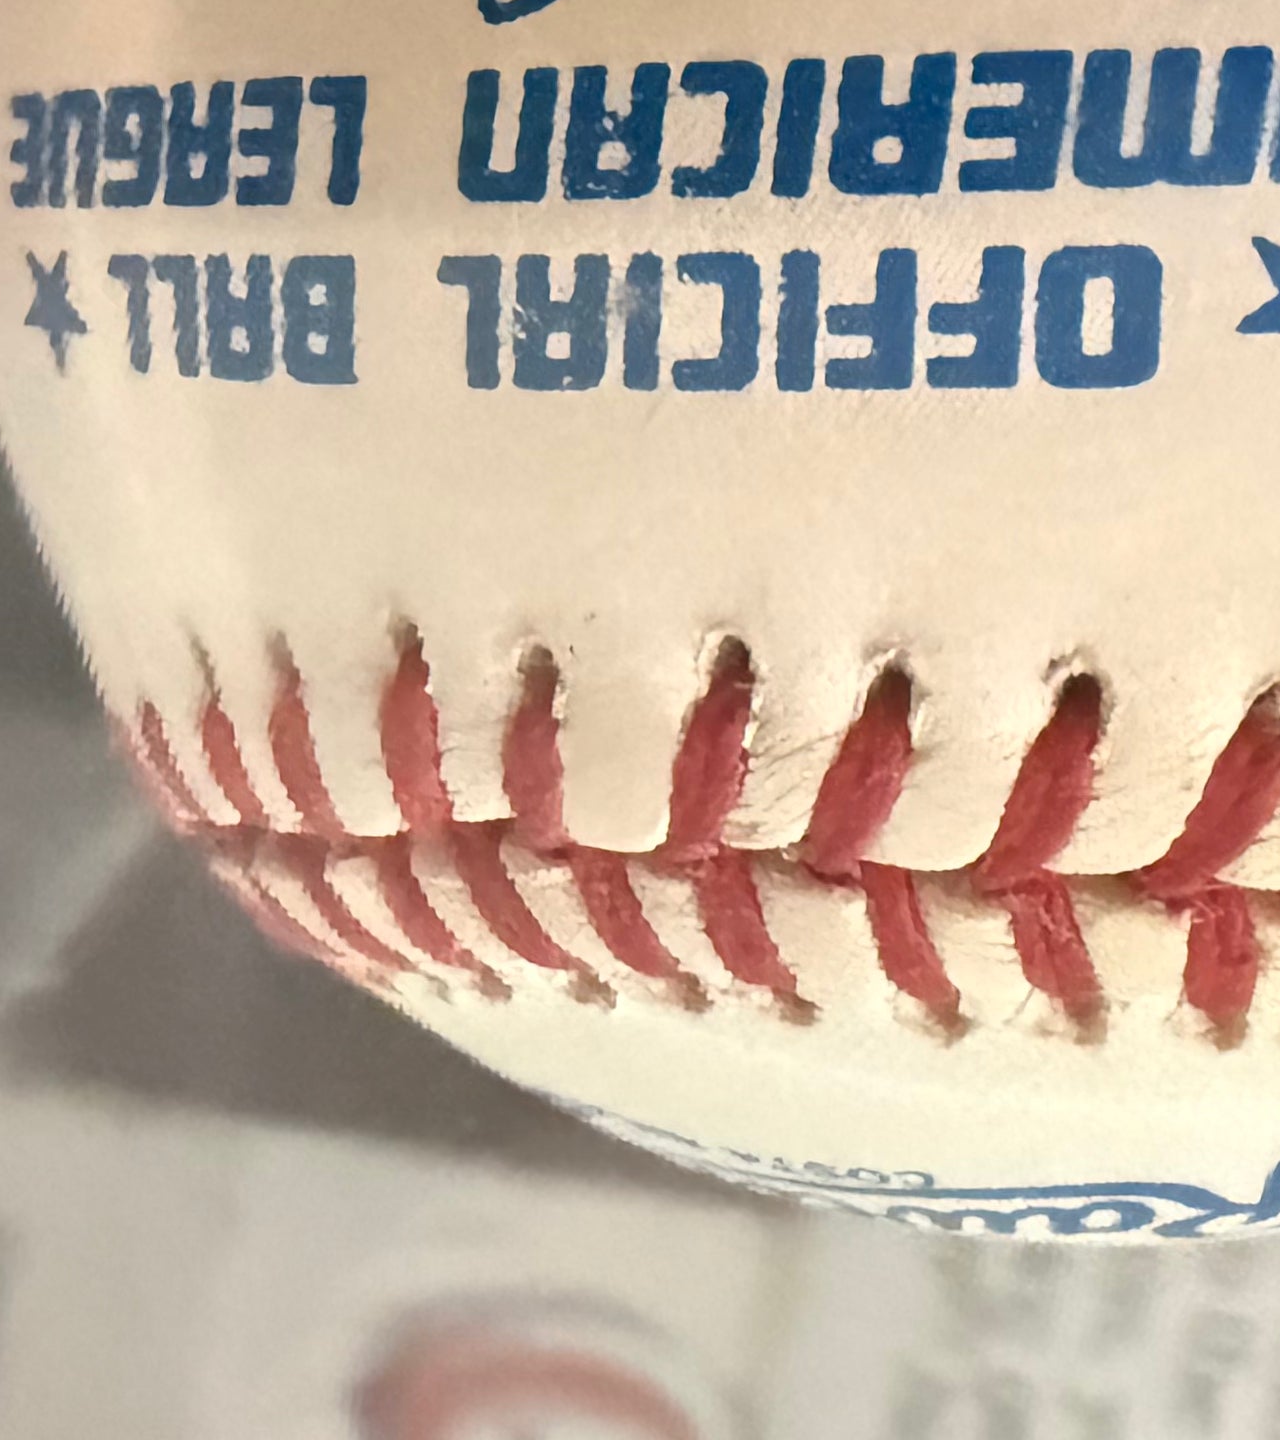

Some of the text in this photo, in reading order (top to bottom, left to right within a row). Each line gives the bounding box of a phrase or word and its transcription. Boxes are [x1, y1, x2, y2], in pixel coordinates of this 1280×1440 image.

[9, 75, 368, 210] LEAGUE
[108, 243, 1164, 393] OFFICIAL BALL
